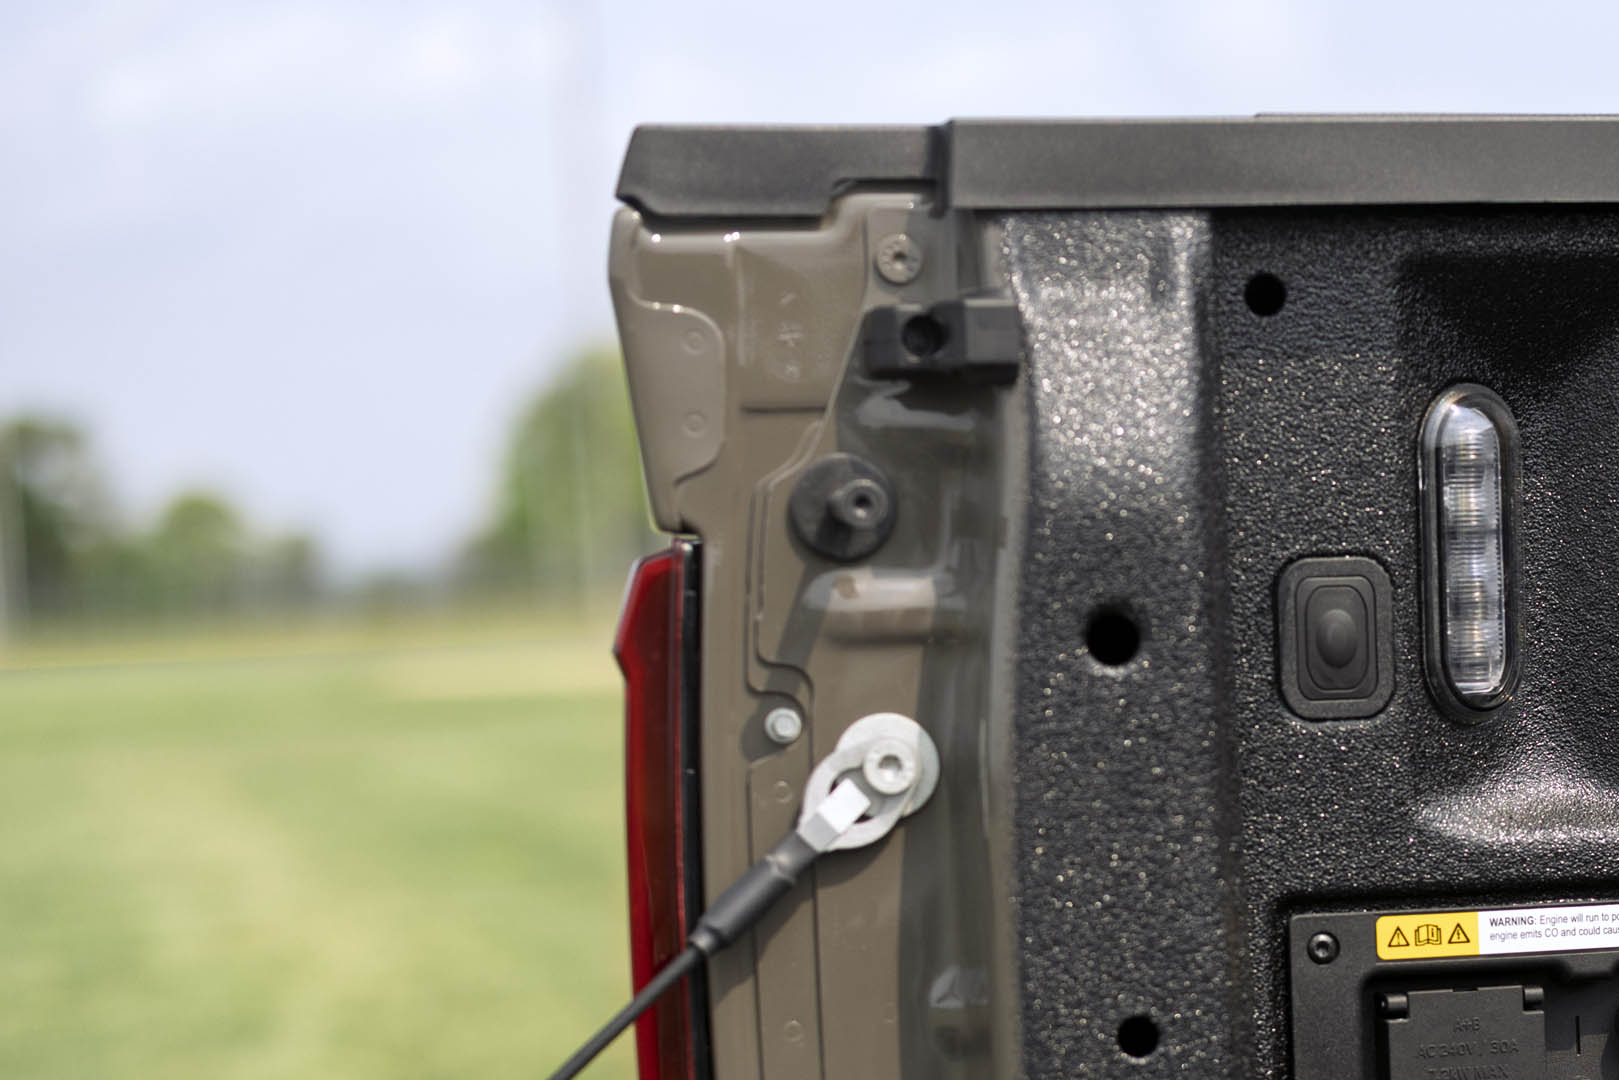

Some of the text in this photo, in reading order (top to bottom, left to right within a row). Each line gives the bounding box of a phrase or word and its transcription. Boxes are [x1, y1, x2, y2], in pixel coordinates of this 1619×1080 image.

[1489, 916, 1537, 927] WARNING:
[1540, 915, 1568, 926] Engine
[1571, 913, 1583, 923] will
[1586, 913, 1599, 922] run
[1601, 912, 1609, 921] to
[1490, 931, 1517, 942] engine
[1520, 930, 1542, 939] emits
[1545, 928, 1558, 937] CO
[1561, 927, 1576, 937] and
[1579, 926, 1600, 935] could
